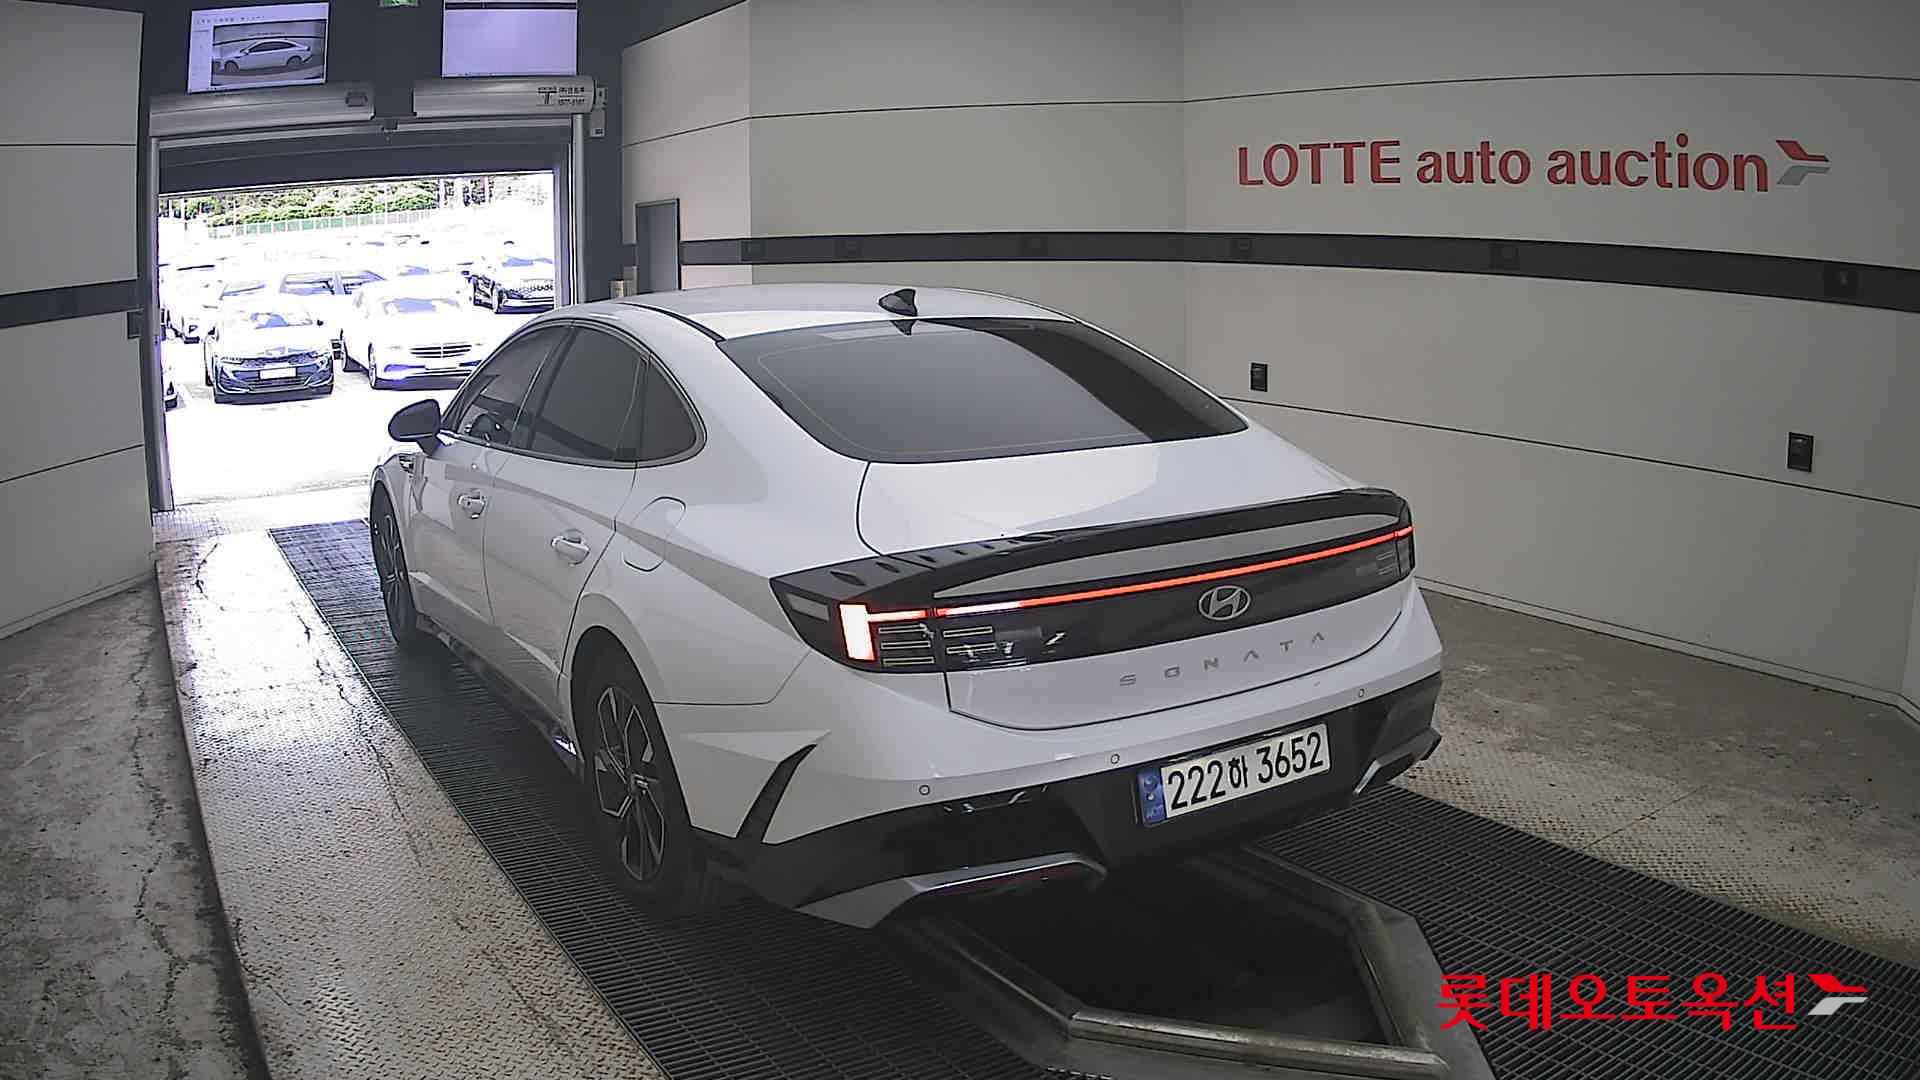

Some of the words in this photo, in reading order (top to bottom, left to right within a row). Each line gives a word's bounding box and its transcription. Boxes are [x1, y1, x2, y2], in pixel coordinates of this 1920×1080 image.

[1238, 140, 1400, 187] LOTTE
[1416, 141, 1531, 184] auto
[1547, 133, 1768, 192] auction
[1119, 632, 1325, 686] SONATA
[1256, 731, 1323, 784] 3652
